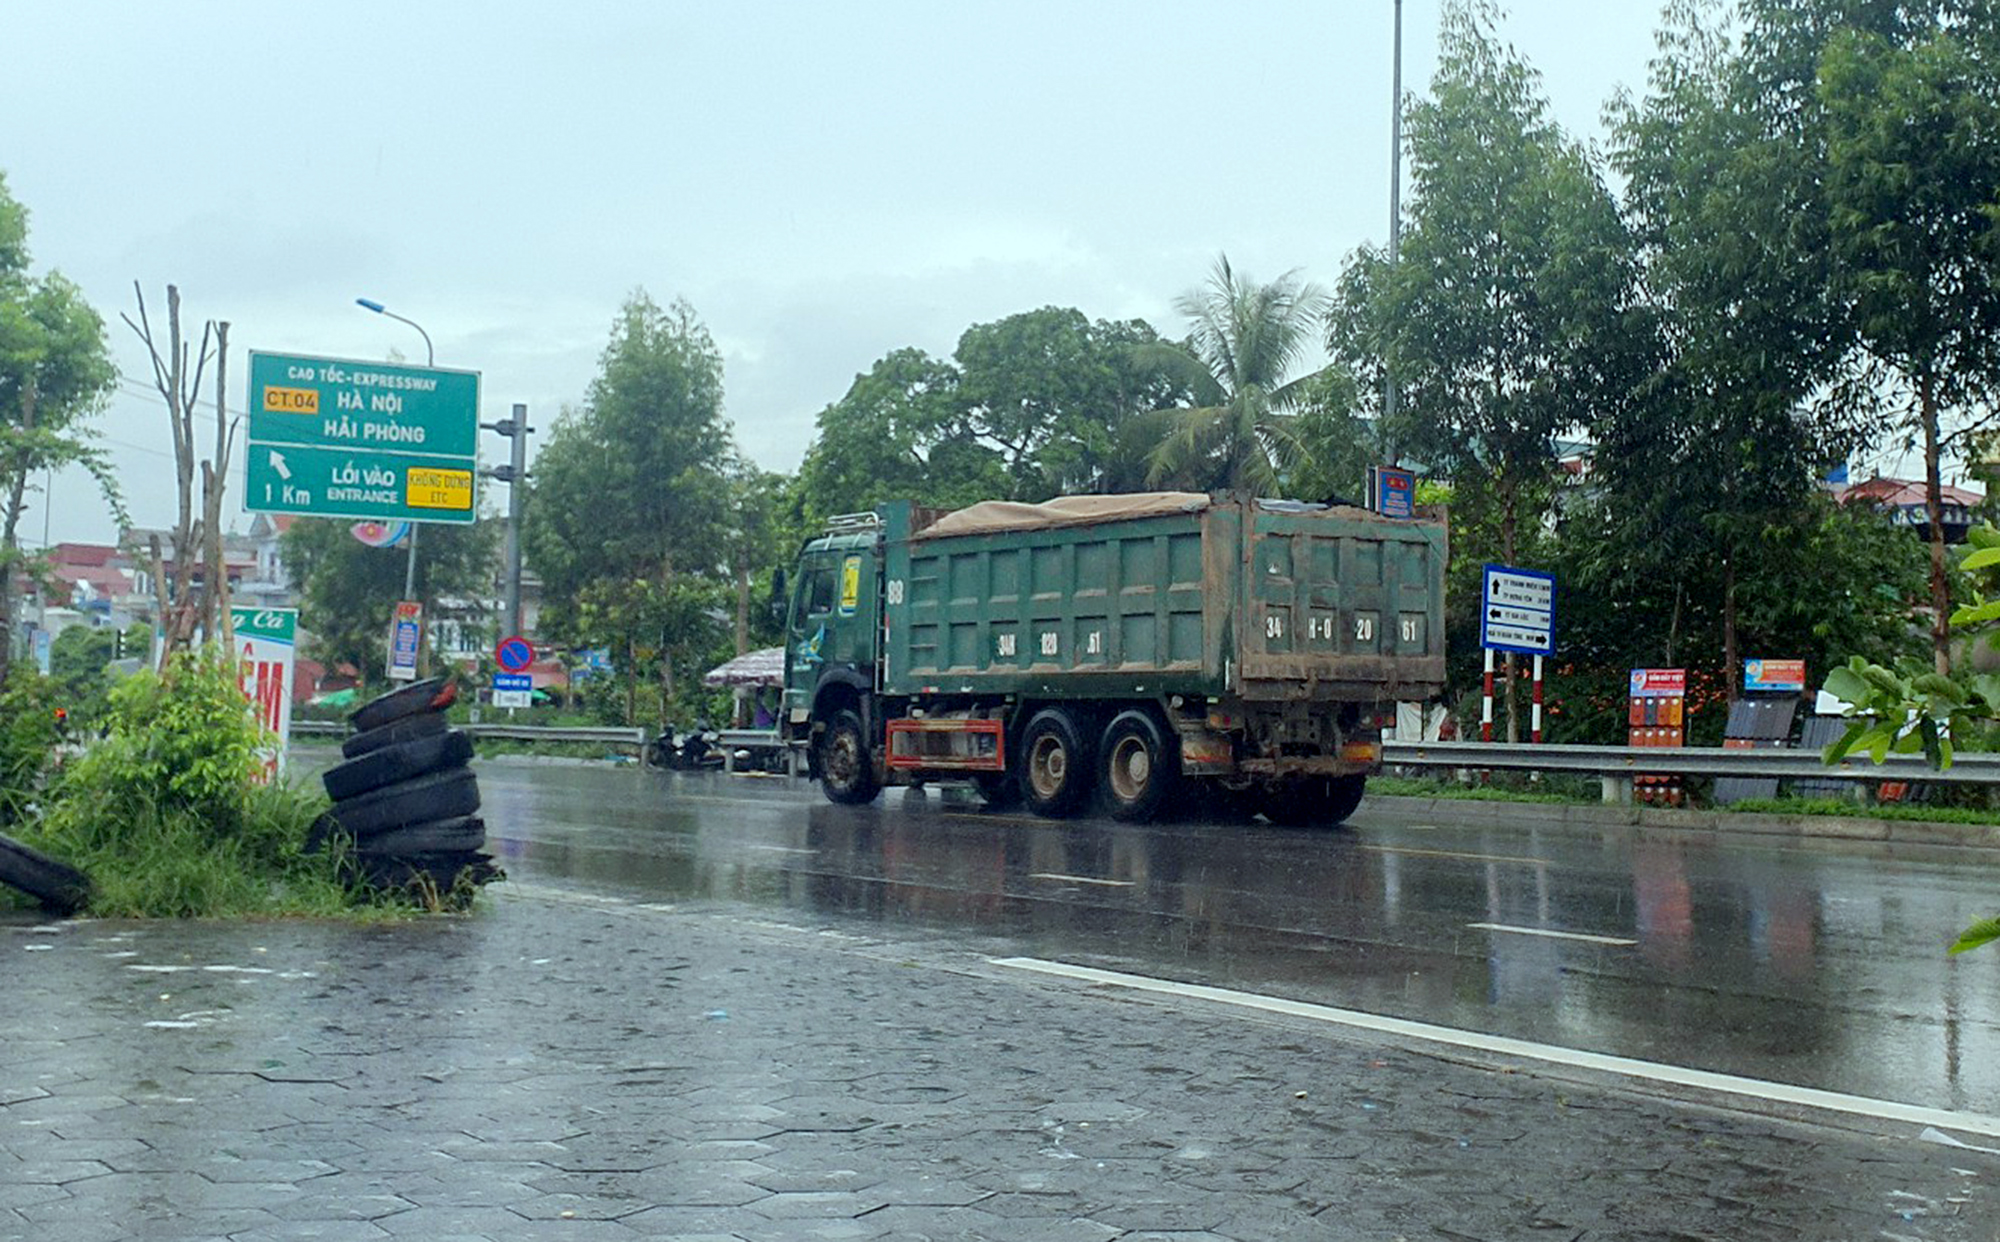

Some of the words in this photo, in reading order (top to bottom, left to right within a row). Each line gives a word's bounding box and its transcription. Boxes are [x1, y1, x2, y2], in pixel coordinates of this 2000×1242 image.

[288, 366, 315, 380] CAO
[320, 364, 437, 391] TỐC-EXPRESSWAY
[266, 391, 316, 409] CT.04
[337, 389, 364, 411] HÀ
[371, 395, 403, 416] NỘI
[324, 416, 358, 439] HẢI
[363, 424, 426, 443] PHÒNG
[332, 460, 360, 485] LỐI
[364, 467, 396, 487] VÀO
[409, 472, 442, 488] KHÔNG
[265, 484, 272, 503] 1
[282, 485, 311, 505] Km
[327, 487, 398, 504] ENTRANCE
[430, 491, 448, 504] ETC
[888, 579, 904, 605] 88
[1266, 617, 1282, 638] 34
[1402, 620, 1417, 642] 61
